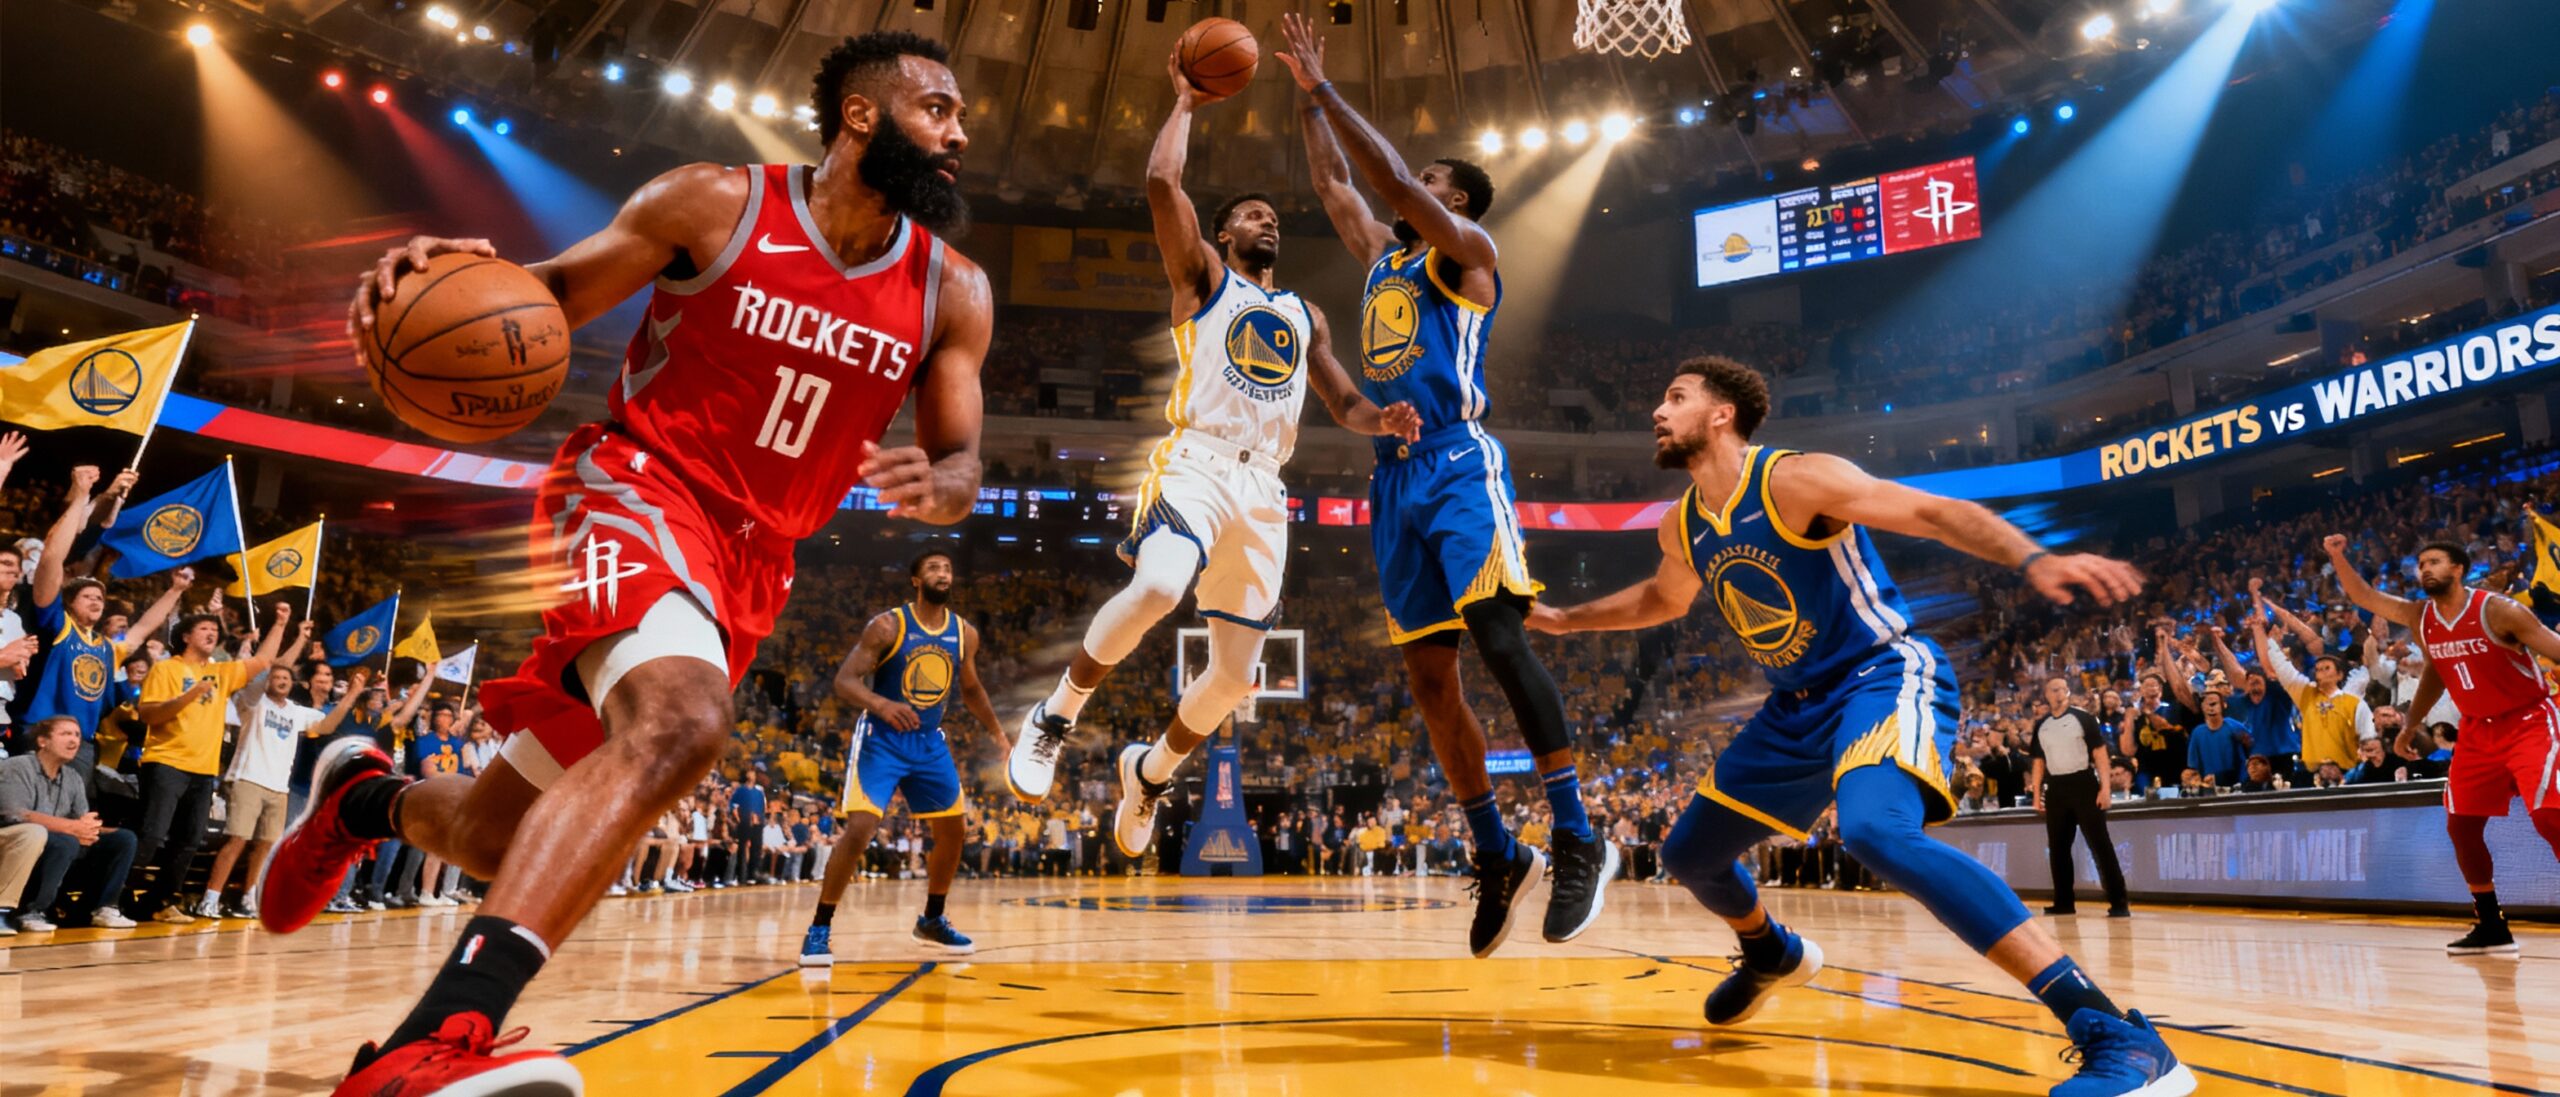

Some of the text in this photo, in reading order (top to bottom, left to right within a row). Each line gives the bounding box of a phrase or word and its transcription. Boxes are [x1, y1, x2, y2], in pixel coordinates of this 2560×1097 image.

[731, 280, 913, 381] ROCKETS
[755, 365, 832, 459] 13
[2100, 313, 2560, 481] ROCKETS VS WARRIORS
